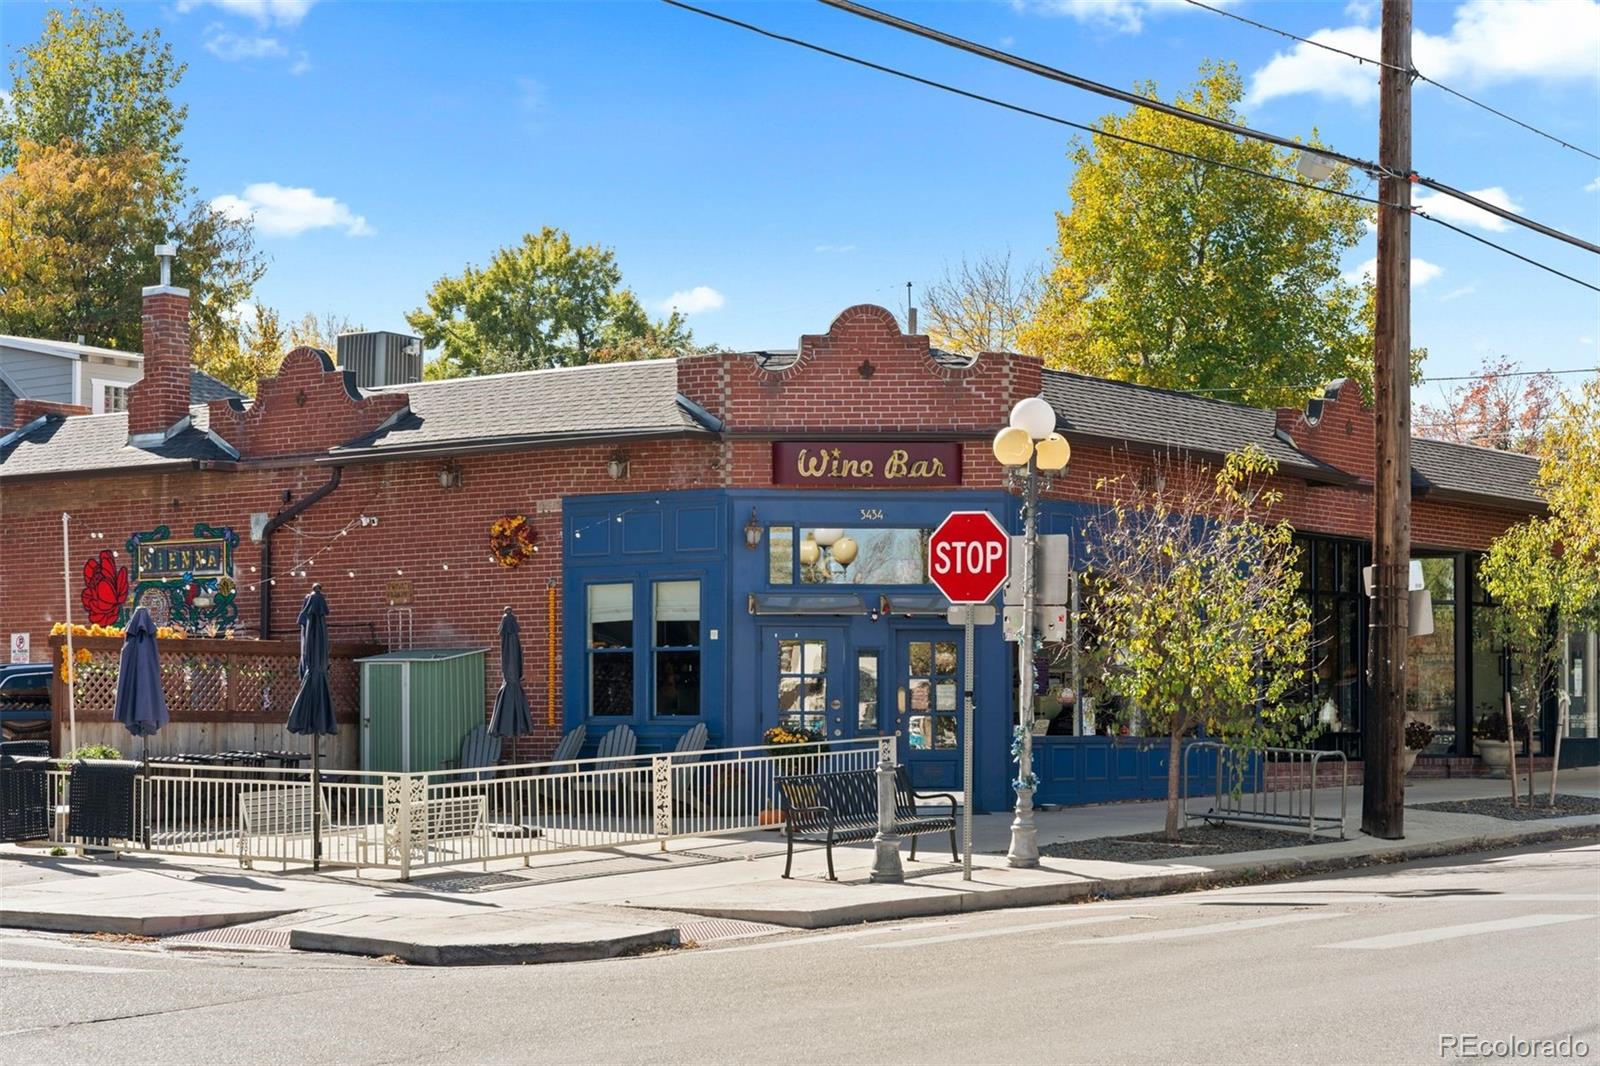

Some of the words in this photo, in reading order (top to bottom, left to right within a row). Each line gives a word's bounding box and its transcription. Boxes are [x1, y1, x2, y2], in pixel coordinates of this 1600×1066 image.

[797, 448, 874, 478] Wine
[884, 449, 946, 479] Bar
[860, 509, 884, 520] 3434
[143, 550, 217, 570] SIENNA
[934, 540, 1003, 574] STOP
